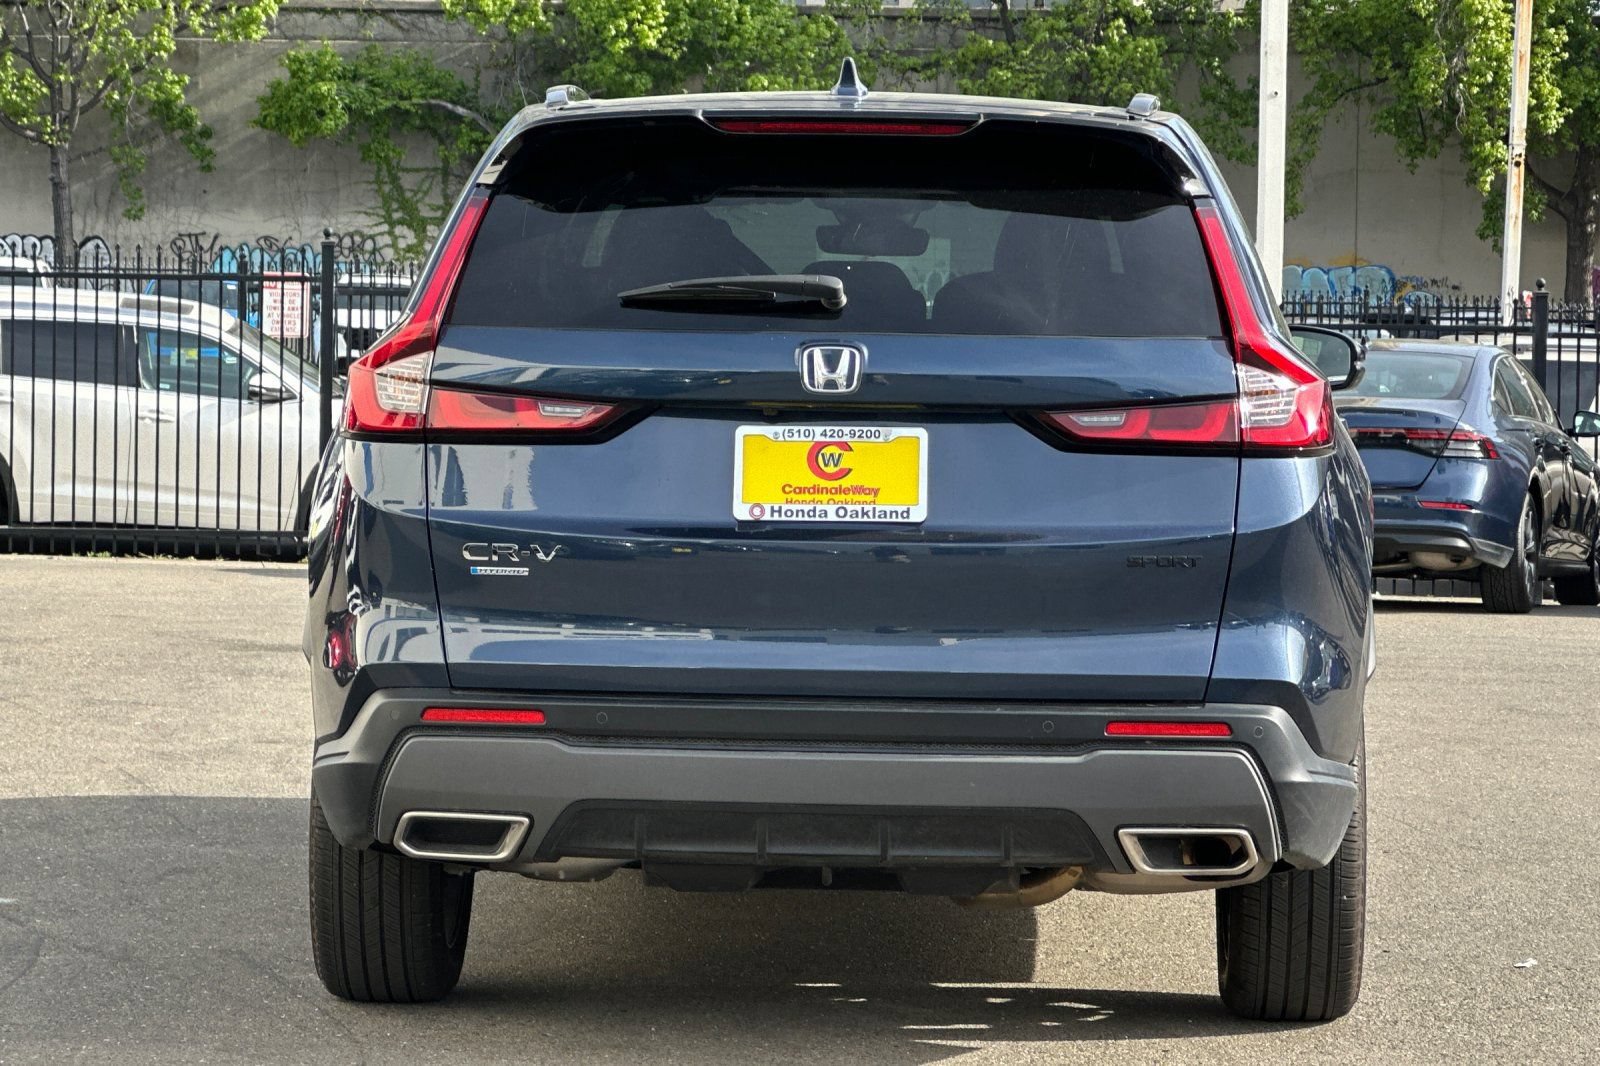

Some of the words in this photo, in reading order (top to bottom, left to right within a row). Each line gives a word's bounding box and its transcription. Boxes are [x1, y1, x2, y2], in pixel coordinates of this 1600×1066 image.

[782, 428, 816, 441] (510)
[819, 428, 881, 440] 420-9200
[781, 483, 881, 498] CardinaleWay
[770, 505, 828, 519] Honda
[835, 506, 911, 520] Oakland
[462, 542, 562, 562] CR-V
[1126, 554, 1204, 568] SPORT
